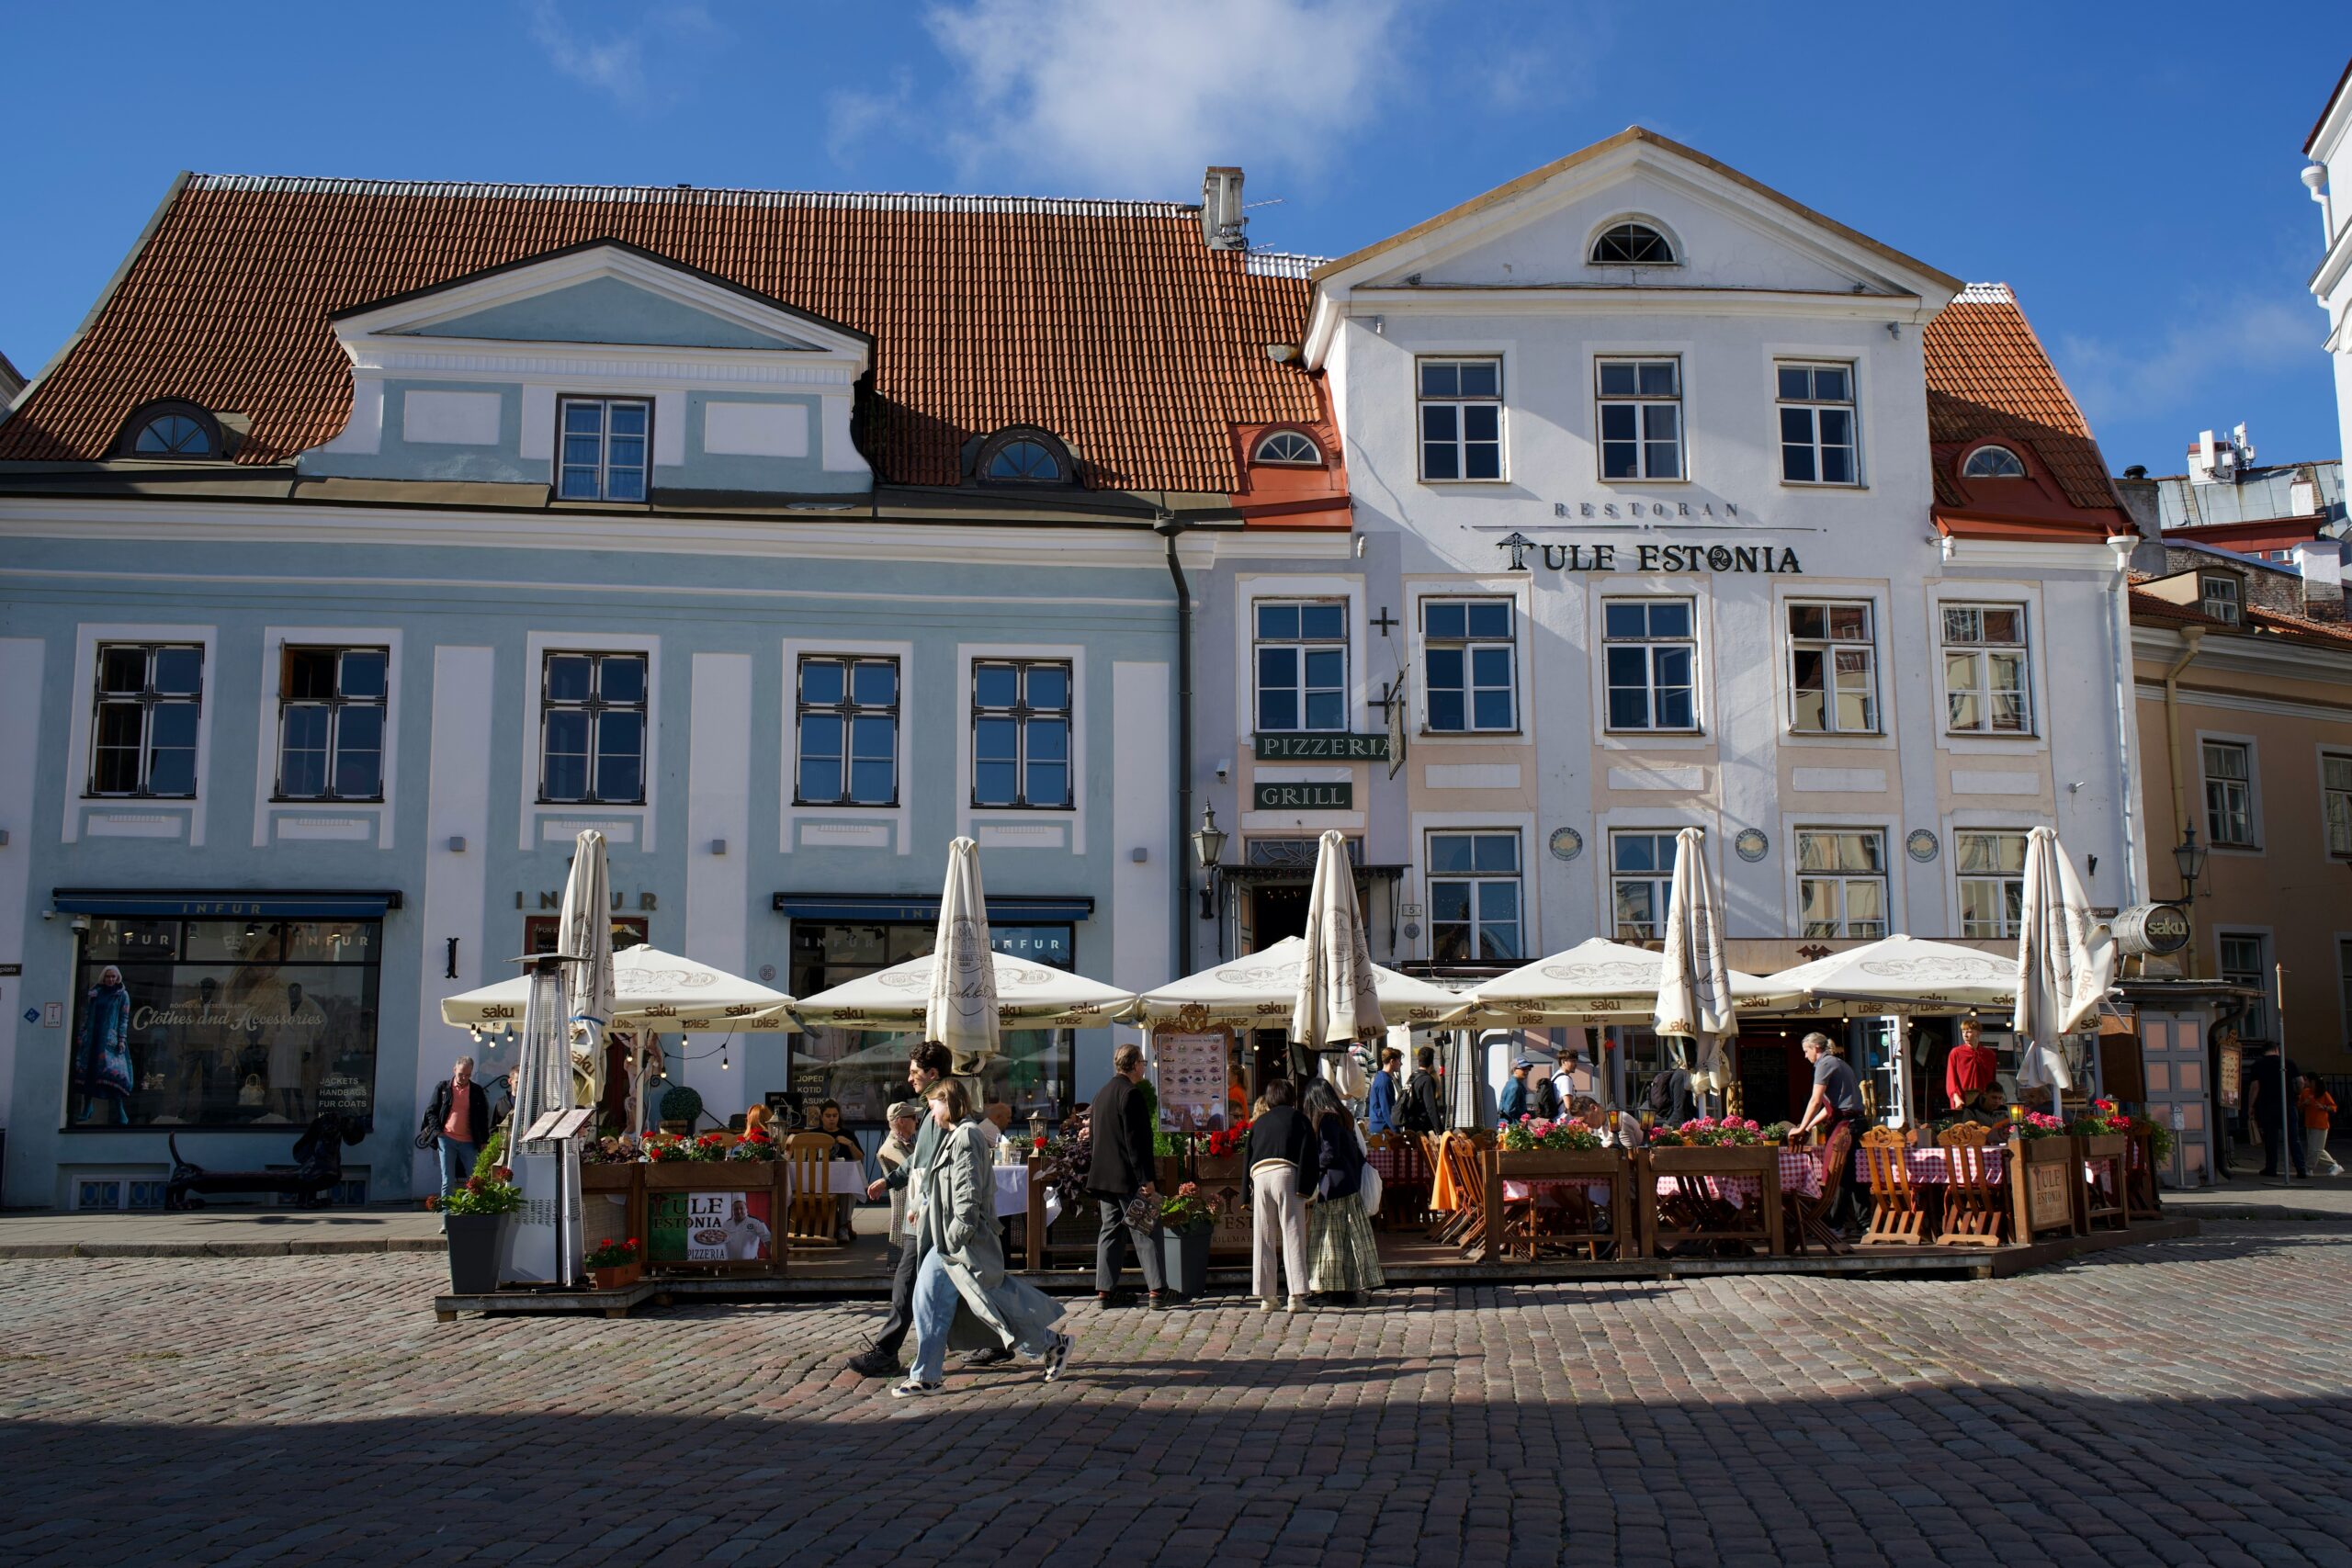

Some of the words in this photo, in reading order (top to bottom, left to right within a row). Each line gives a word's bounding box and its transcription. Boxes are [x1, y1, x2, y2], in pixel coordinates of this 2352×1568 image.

[1554, 502, 1739, 517] RESTORAN
[1636, 545, 1803, 573] ESTONIA
[1263, 738, 1390, 756] PIZZERIA
[1261, 787, 1345, 805] GRILL
[515, 890, 658, 910] INUR
[183, 903, 262, 914] INFUR
[899, 908, 939, 919] INF
[1408, 906, 1415, 915] 5
[2147, 917, 2188, 935] saku
[95, 934, 169, 945] INFUR
[295, 935, 369, 946] INFUR
[991, 939, 1060, 950] INFUR
[1257, 1001, 1288, 1015] saku
[1517, 999, 1546, 1011] saku
[1590, 999, 1621, 1010] saku
[1740, 995, 1770, 1008] saku
[481, 1004, 514, 1018] saku
[645, 1003, 677, 1017] saku
[725, 1004, 757, 1017] saku
[833, 1007, 865, 1021] saku
[911, 1008, 927, 1019] sa
[999, 1005, 1023, 1017] aku
[1069, 1002, 1101, 1015] saku
[1409, 1006, 1440, 1019] saku
[132, 1005, 194, 1030] Clothes
[198, 1010, 230, 1025] and
[230, 1007, 323, 1032] Accessories
[2080, 1015, 2102, 1029] sak
[1669, 1018, 1695, 1033] saku
[320, 1077, 359, 1085] JACKETS
[319, 1089, 368, 1097] HANDBAGS
[319, 1100, 336, 1108] FUR
[337, 1100, 368, 1108] COATS
[650, 1194, 724, 1217] TULE
[653, 1216, 722, 1229] ESTONIA
[687, 1248, 725, 1259] PIZZERIA
